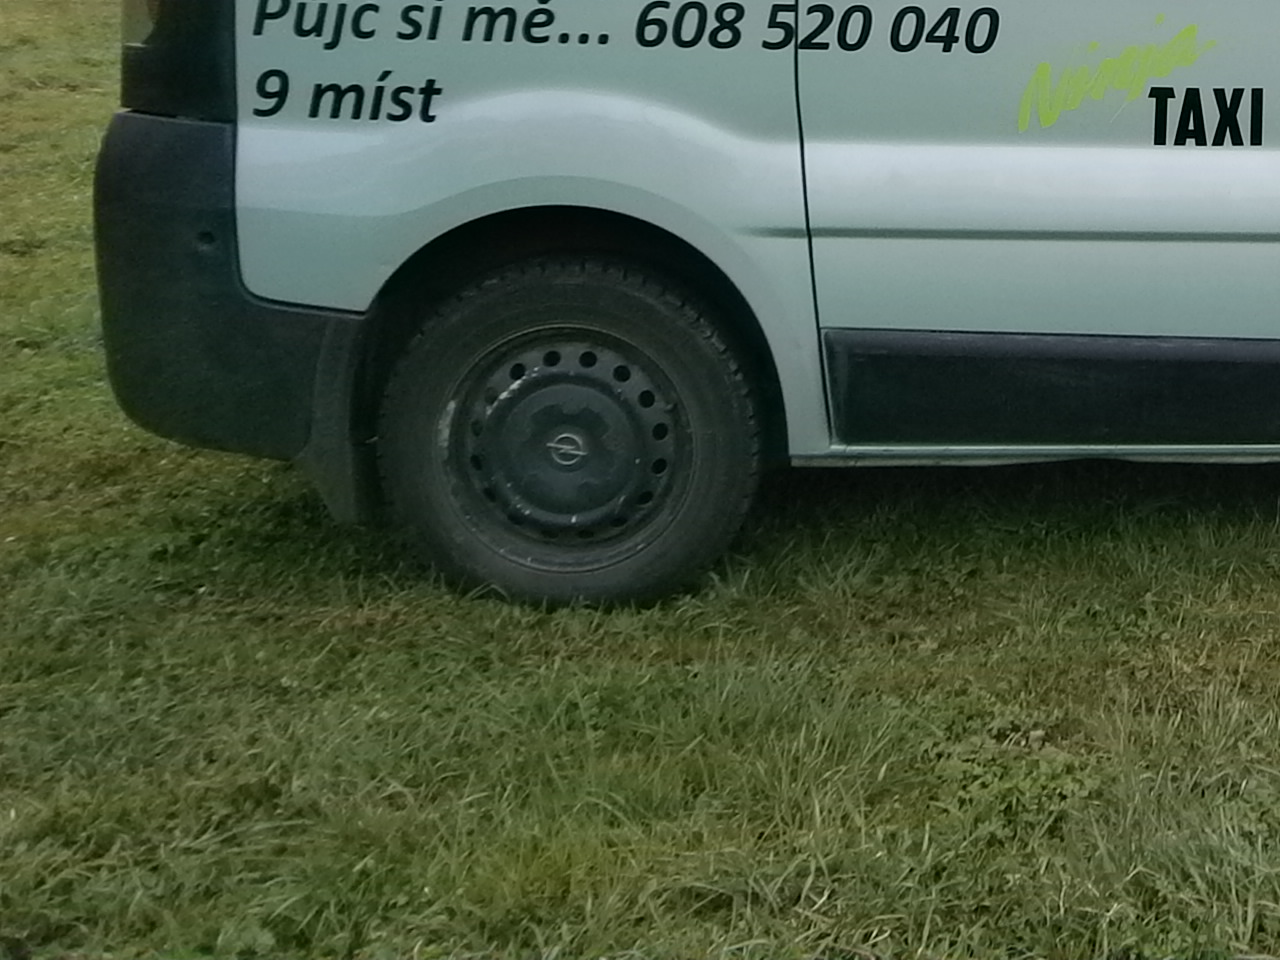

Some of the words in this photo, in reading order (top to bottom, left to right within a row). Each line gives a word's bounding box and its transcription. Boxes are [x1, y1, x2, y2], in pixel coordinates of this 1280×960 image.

[635, 0, 746, 50] 608
[761, 2, 873, 52] 520
[889, 5, 1000, 54] 040
[252, 68, 290, 118] 9
[307, 69, 444, 123] míst
[1147, 86, 1264, 147] TAXI
